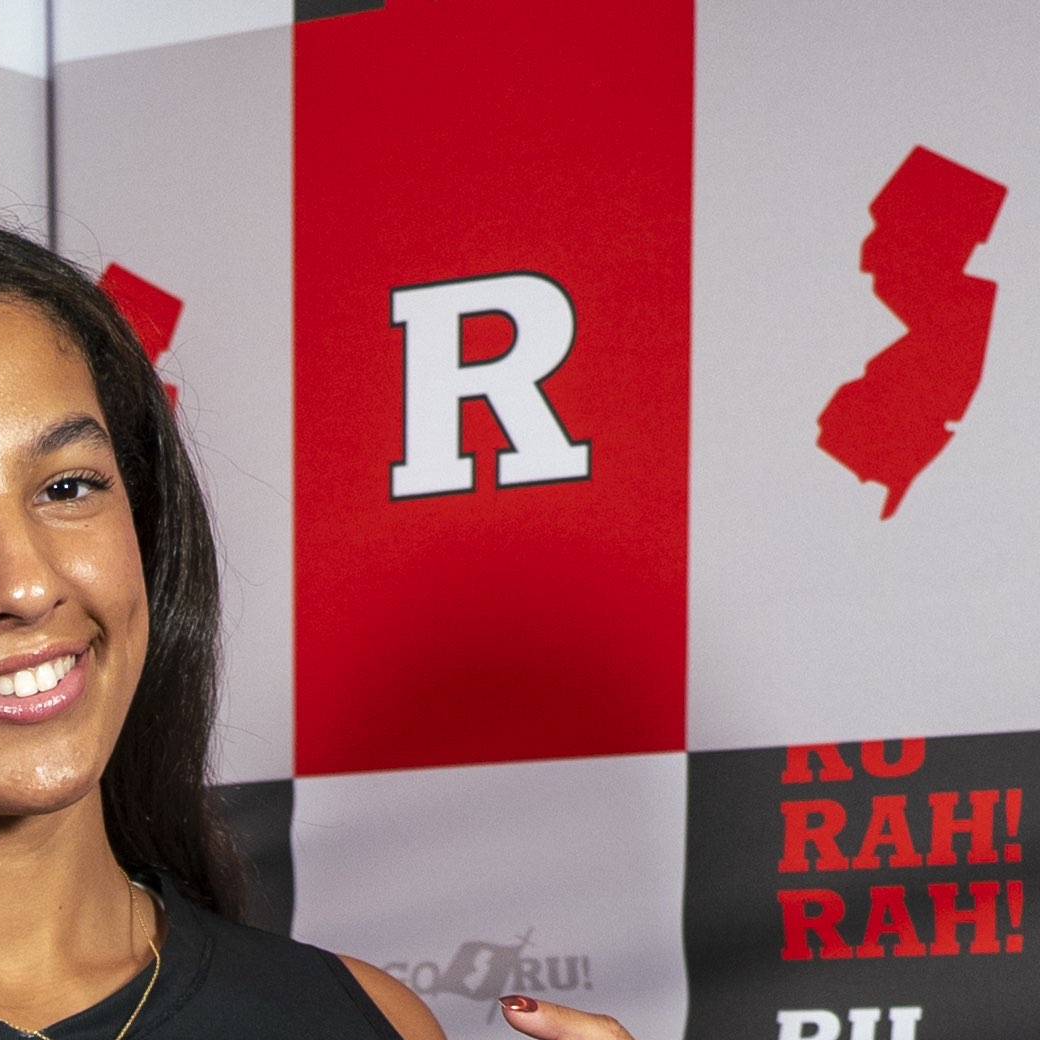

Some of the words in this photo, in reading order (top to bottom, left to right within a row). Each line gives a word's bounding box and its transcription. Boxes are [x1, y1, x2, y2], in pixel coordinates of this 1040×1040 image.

[389, 270, 591, 502] R
[778, 788, 1023, 873] RAH!
[777, 880, 1024, 960] RAH!
[512, 955, 593, 992] RU!
